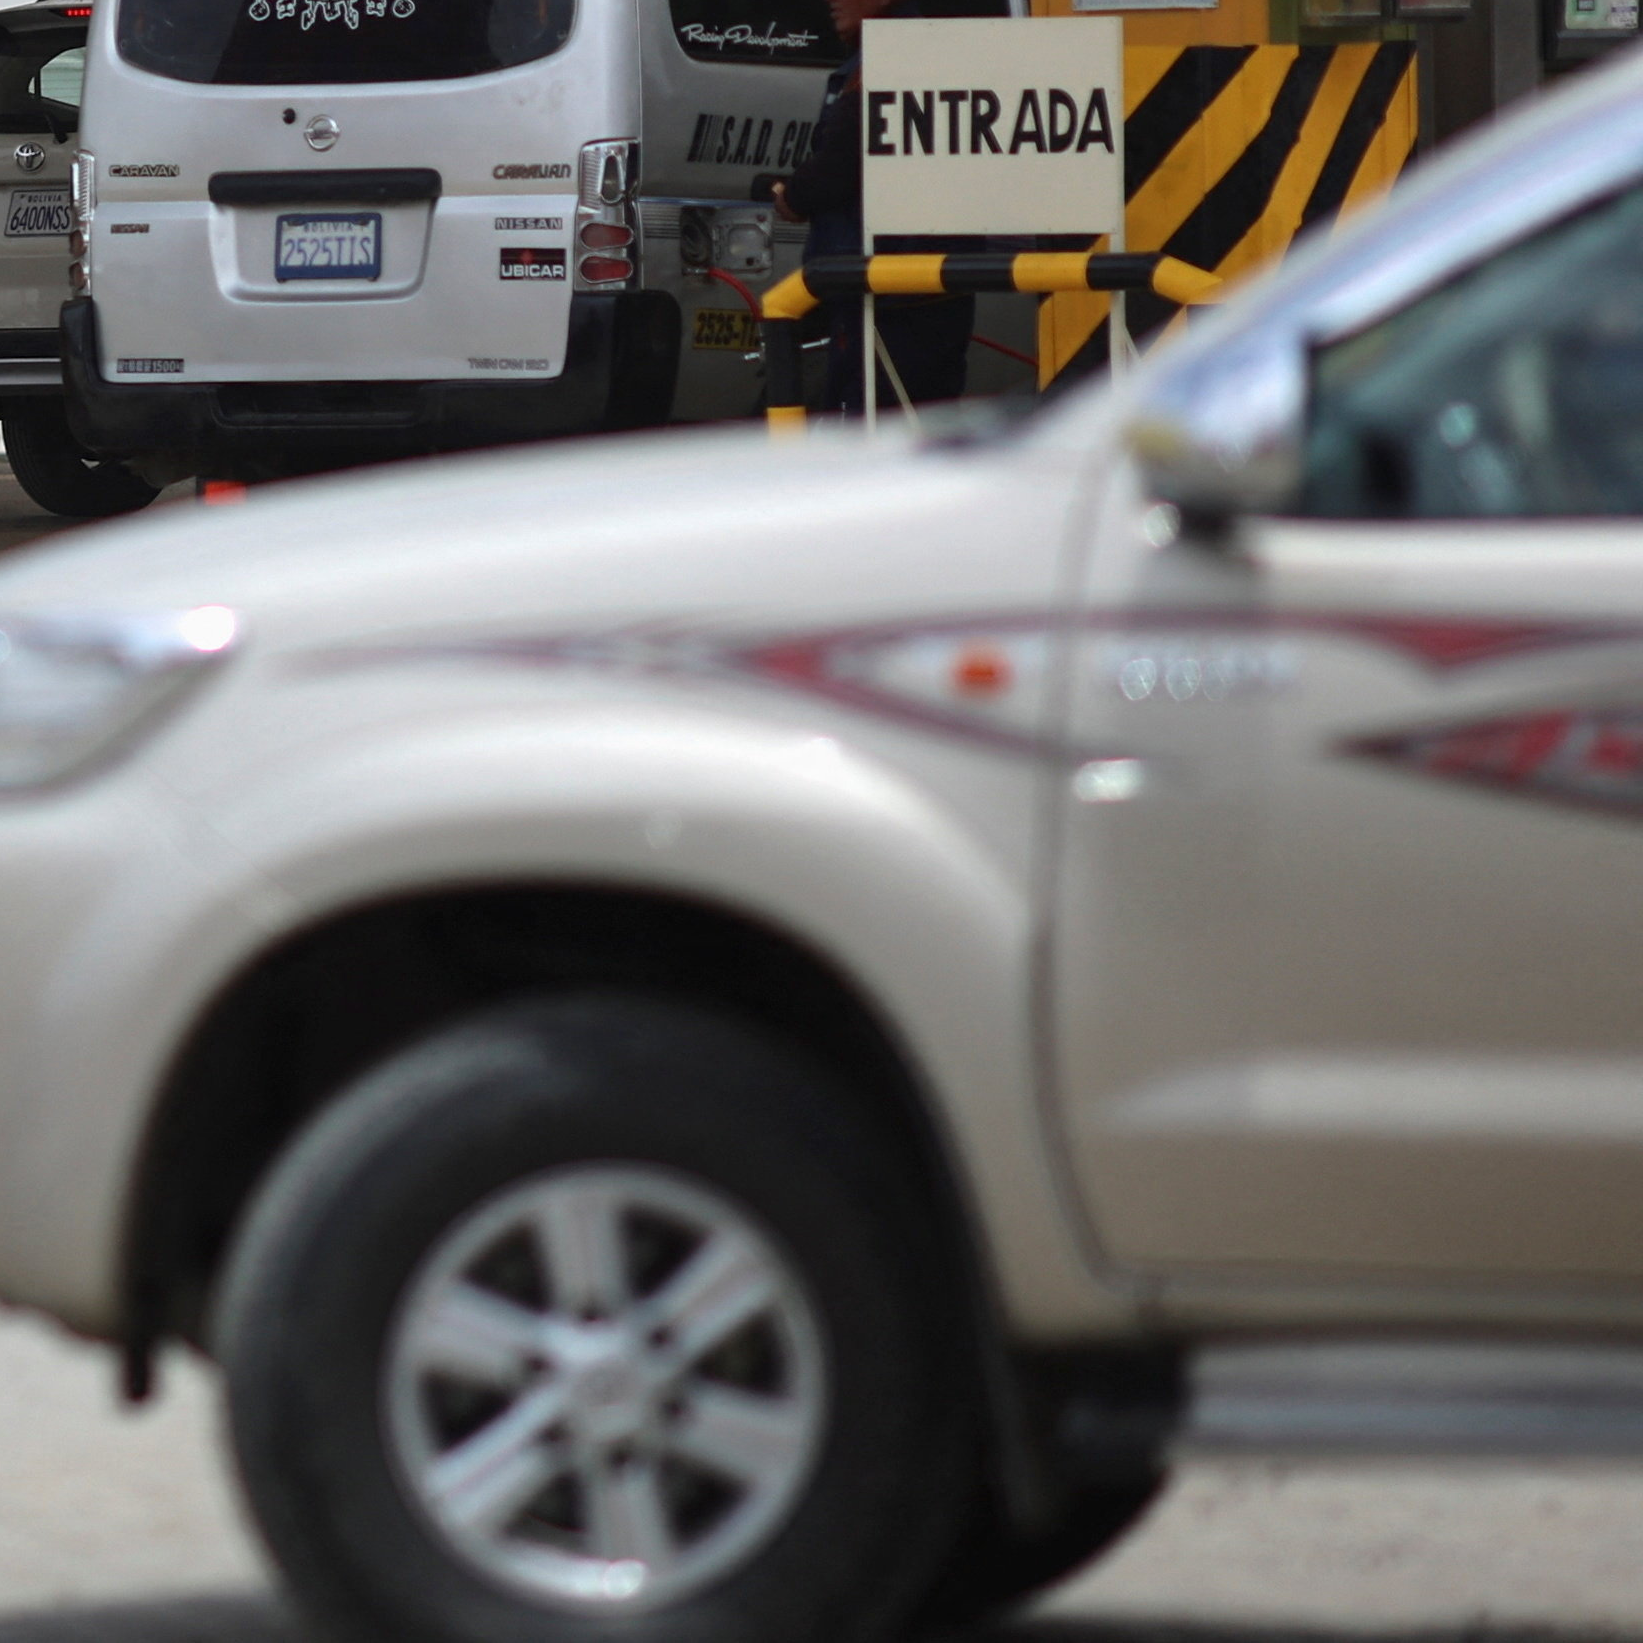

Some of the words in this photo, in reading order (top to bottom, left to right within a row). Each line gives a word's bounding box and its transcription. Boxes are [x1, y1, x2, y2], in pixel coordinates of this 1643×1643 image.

[681, 24, 725, 51] Racing
[867, 87, 1115, 157] ENTRADA
[109, 164, 180, 177] CARAVAN
[27, 195, 62, 203] BOLIVIA
[10, 206, 71, 231] 6400NSS
[495, 218, 562, 229] NISSAN
[501, 264, 564, 277] UBICAR
